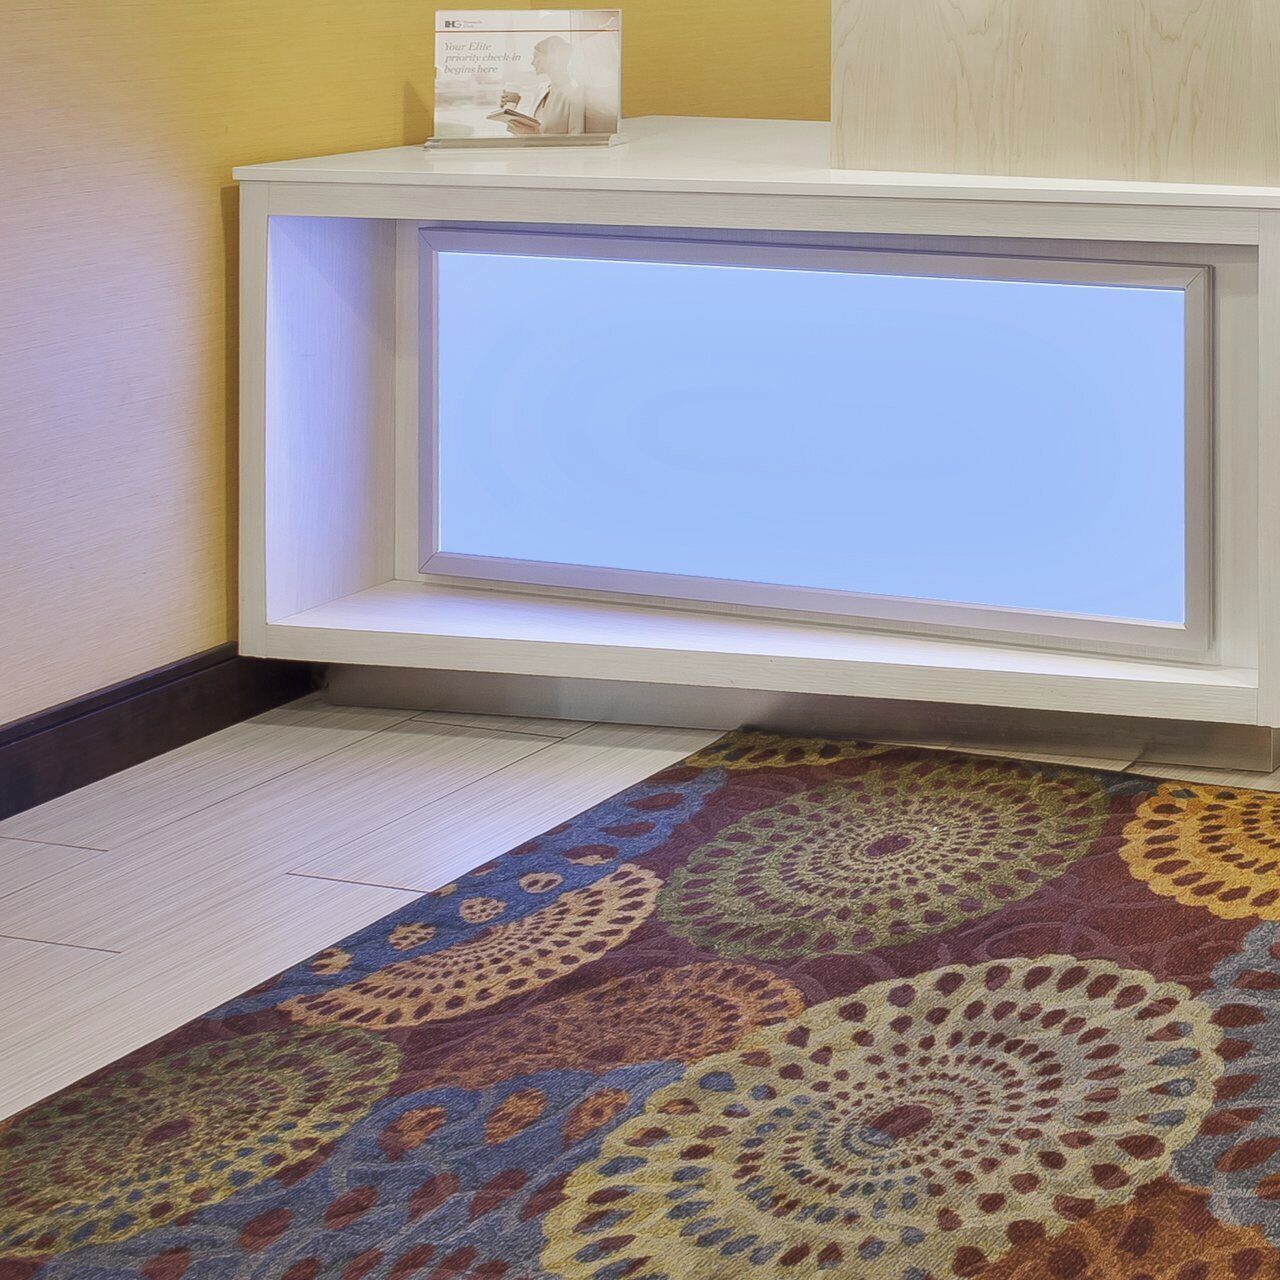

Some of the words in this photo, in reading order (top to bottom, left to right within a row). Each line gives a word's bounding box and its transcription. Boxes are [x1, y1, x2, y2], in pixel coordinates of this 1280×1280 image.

[445, 42, 466, 51] Your
[468, 41, 492, 51] Elite
[444, 54, 481, 64] priority
[482, 52, 521, 62] check-in
[444, 64, 476, 75] begins
[477, 64, 499, 74] here
